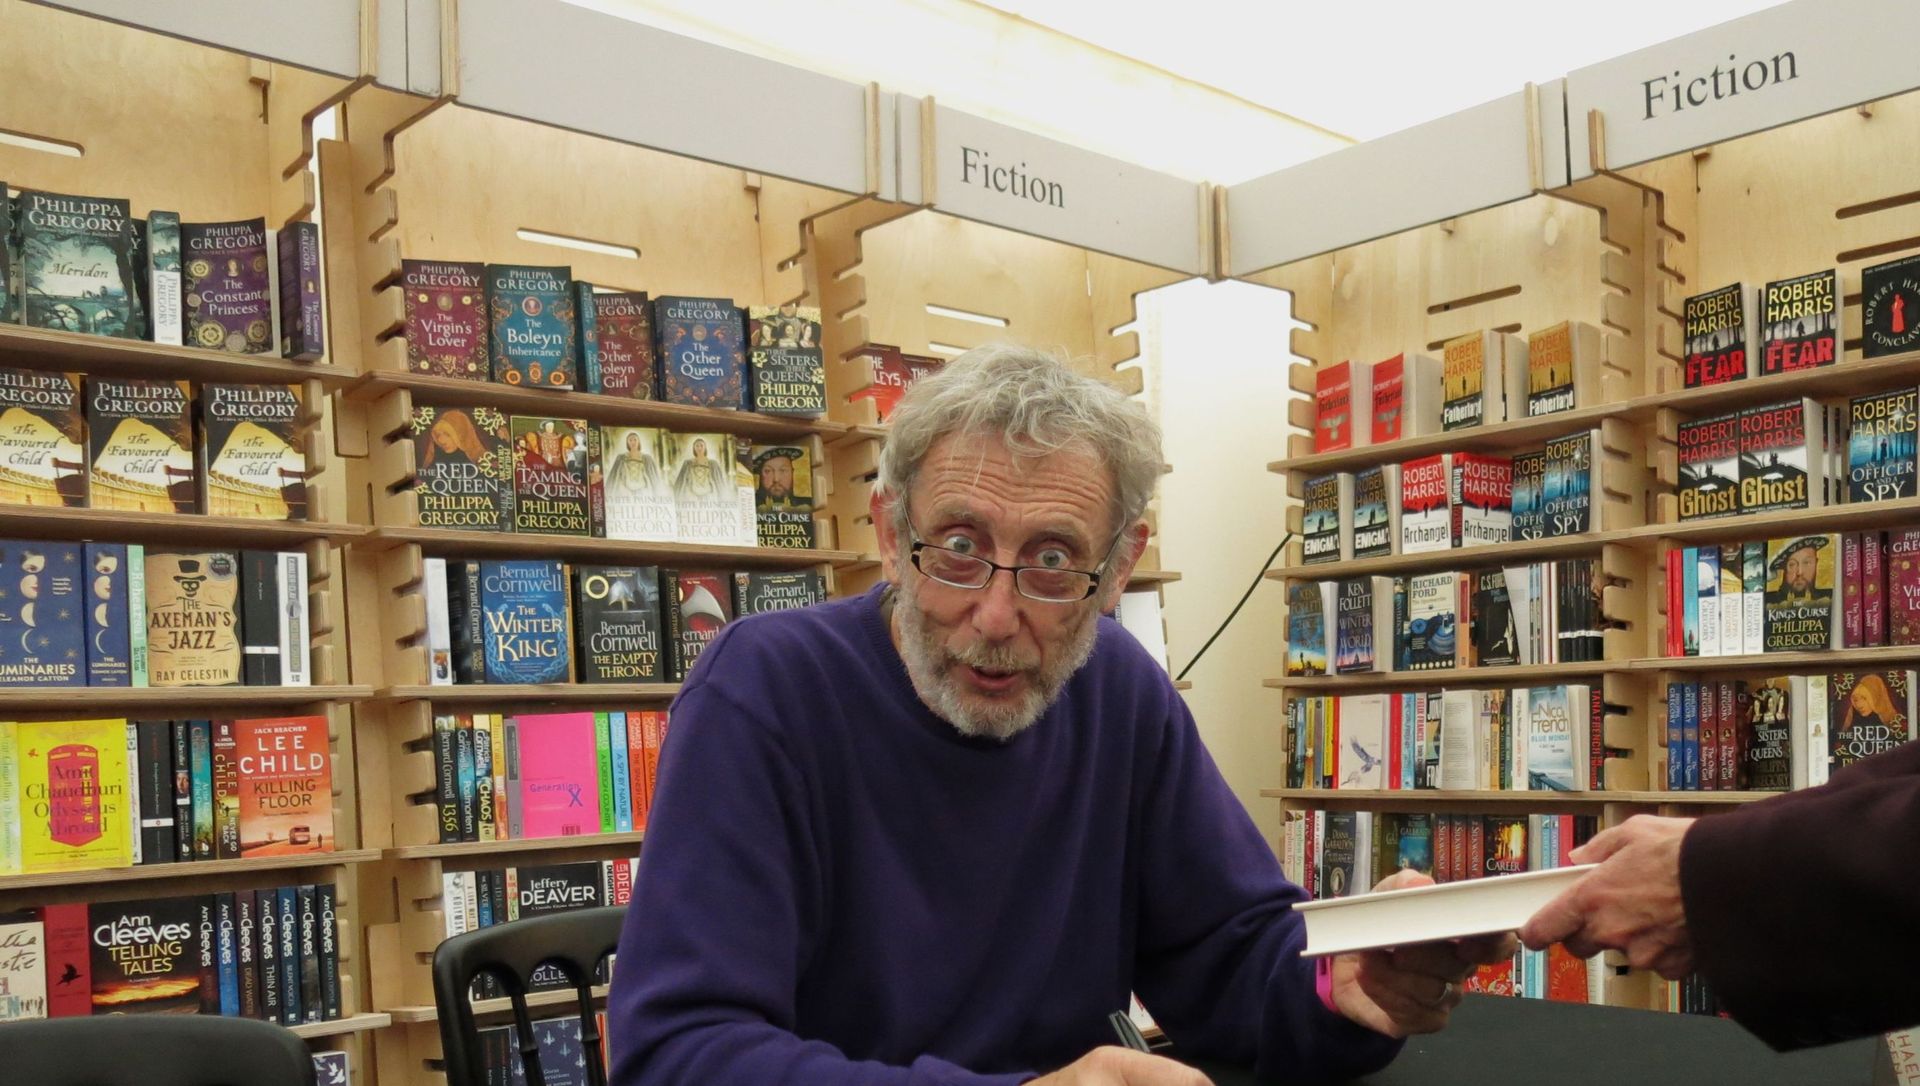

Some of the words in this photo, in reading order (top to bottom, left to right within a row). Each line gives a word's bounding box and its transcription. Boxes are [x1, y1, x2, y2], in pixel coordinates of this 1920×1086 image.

[1641, 50, 1799, 121] Fiction
[960, 145, 1065, 209] Fiction
[32, 195, 122, 217] PHILIPPA
[28, 210, 125, 232] GREGORY
[190, 232, 266, 250] GREGORY
[205, 225, 253, 238] PHILIPPA
[48, 262, 110, 279] Meridon
[421, 265, 466, 275] PHILIPPA
[509, 270, 553, 280] PHILIPPA
[222, 279, 244, 290] The
[407, 274, 481, 287] GREGORY
[496, 279, 567, 292] GREGORY
[1768, 275, 1834, 305] ROBERT
[202, 290, 263, 305] Constant
[678, 300, 717, 310] PHILIPPA
[1687, 290, 1740, 320] ROBERT
[1865, 281, 1894, 326] ROBERT
[208, 302, 259, 316] Princess
[437, 312, 453, 321] The
[667, 309, 730, 321] GREGORY
[1767, 295, 1834, 324] HARRIS
[421, 319, 473, 338] Virgin's
[526, 318, 542, 328] The
[1687, 309, 1742, 338] HARRIS
[427, 333, 468, 347] Lover
[507, 328, 563, 350] Boleyn
[605, 341, 622, 350] The
[692, 342, 710, 352] The
[1529, 327, 1570, 354] ROBERT
[508, 345, 561, 357] Inheritance
[681, 351, 722, 365] Other
[1444, 337, 1484, 363] ROBERT
[1766, 337, 1834, 371] FEAR
[1444, 357, 1483, 378] HARRIS
[1529, 351, 1572, 370] HARRIS
[1686, 350, 1744, 385] FEAR
[603, 375, 628, 388] Girl
[680, 364, 725, 381] Queen
[759, 370, 811, 383] QUEENS
[98, 382, 184, 399] PHILIPPA
[214, 387, 297, 402] PHILIPPA
[760, 383, 819, 397] PHILIPPA
[94, 397, 186, 414] GREGORY
[210, 402, 299, 418] GREGORY
[756, 396, 823, 409] GREGORY
[1444, 398, 1482, 425] Fatherland
[1529, 390, 1575, 417] Fatherland
[1852, 393, 1917, 421] ROBERT
[13, 423, 38, 436] The
[1740, 407, 1802, 433] ROBERT
[1852, 413, 1917, 439] HARRIS
[127, 434, 151, 446] The
[242, 435, 265, 448] The
[1679, 420, 1737, 447] ROBERT
[1740, 427, 1803, 453] HARRIS
[107, 444, 174, 458] Favoured
[223, 448, 287, 462] Favoured
[1546, 436, 1590, 460] ROBERT
[1679, 439, 1738, 464] HARRIS
[8, 451, 46, 466] Child
[123, 459, 158, 475] Child
[1546, 453, 1590, 474] HARRIS
[239, 461, 274, 477] Child
[418, 468, 436, 477] THE
[435, 463, 478, 480] RED
[516, 467, 582, 485] TAMING
[1403, 461, 1443, 485] ROBERT
[1464, 460, 1512, 482] ROBERT
[1852, 461, 1914, 482] OFFICER
[431, 478, 499, 496] QUEEN
[532, 482, 587, 501] QUEEN
[1304, 480, 1338, 500] ROBERT
[1403, 479, 1446, 501] HARRIS
[1464, 479, 1513, 498] HARRIS
[1740, 474, 1806, 507] Ghost
[1863, 479, 1907, 502] SPY
[424, 496, 494, 510] PHILIPPA
[521, 500, 584, 516] PHILIPPA
[1304, 496, 1339, 515] HARRIS
[1545, 496, 1589, 514] OFFICER
[1679, 481, 1737, 517] Ghost
[418, 511, 500, 526] GREGORY
[517, 514, 588, 530] GREGORY
[778, 511, 810, 523] CURSE
[1552, 513, 1583, 536] SPY
[1355, 527, 1390, 550] ENIGMA
[1404, 520, 1449, 543] Archangel
[1464, 518, 1511, 543] Archangel
[1304, 533, 1340, 555] ENIGMA
[500, 564, 550, 579] Bernard
[468, 575, 480, 609] Bernard
[485, 574, 562, 592] Cornwell
[763, 582, 806, 598] Bernard
[1347, 582, 1364, 595] KEN
[1412, 575, 1453, 590] RICHARD
[754, 591, 816, 614] Cornwell
[1339, 593, 1372, 612] FOLLETT
[1412, 588, 1438, 600] FORD
[176, 597, 201, 611] THE
[516, 605, 537, 616] THE
[151, 610, 231, 628] AXEMAN'S
[487, 611, 563, 634] WINTER
[1339, 613, 1372, 630] WINTER
[1768, 608, 1797, 621] KING'S
[1797, 607, 1829, 619] CURSE
[471, 608, 481, 645] Cornwell
[600, 620, 646, 637] Bernard
[1772, 620, 1824, 634] PHILIPPA
[168, 630, 216, 649] JAZZ
[497, 634, 557, 662] KING
[591, 631, 657, 653] Cornwell
[1767, 632, 1828, 648] GREGORY
[592, 655, 612, 664] THE
[612, 651, 658, 665] EMPTY
[156, 669, 175, 682] RAY
[180, 668, 229, 681] CELESTIN
[598, 664, 653, 679] THRONE
[1592, 689, 1601, 715] TANA
[253, 726, 272, 734] JACK
[274, 725, 308, 733] REACHER
[1416, 715, 1425, 742] FRANCIS
[1531, 712, 1569, 734] French
[1592, 716, 1601, 754] FRENCH
[1837, 732, 1853, 740] THE
[1853, 726, 1890, 741] RED
[257, 736, 306, 751] LEE
[441, 732, 453, 763] Bernard
[1751, 747, 1783, 761] QUEENS
[240, 754, 324, 774] CHILD
[215, 754, 227, 798] CHILD
[226, 762, 237, 788] LEE
[442, 763, 455, 799] Cornwell
[254, 779, 317, 794] KILLING
[529, 783, 580, 793] Generation
[259, 794, 313, 809] FLOOR
[481, 783, 492, 820] CHAOS
[568, 787, 584, 807] X
[619, 788, 627, 818] NATURE
[463, 780, 473, 834] Postmortem
[602, 793, 611, 826] COUNTRY
[442, 804, 459, 832] 1356
[1438, 824, 1446, 870] SILKWORM
[1454, 824, 1463, 871] SILKWORM
[1472, 825, 1480, 871] SILKWORM
[1486, 857, 1520, 872] CAREER
[530, 877, 568, 892] Jeffery
[481, 884, 489, 908] SILVER
[520, 885, 596, 906] DEAVER
[201, 905, 209, 921] Ann
[221, 903, 229, 919] Ann
[241, 902, 249, 918] Ann
[118, 914, 152, 927] Ann
[93, 922, 192, 948] Cleeves
[240, 918, 254, 964] Cleeves
[262, 915, 276, 960] Cleeves
[282, 913, 295, 958] Cleeves
[302, 912, 316, 956] Cleeves
[322, 910, 335, 954] Cleeves
[108, 941, 183, 962] TELLING
[200, 921, 214, 968] Cleeves
[220, 919, 234, 965] Cleeves
[119, 958, 173, 976] TALES
[266, 964, 275, 989] THIN
[267, 990, 277, 1007] AIR
